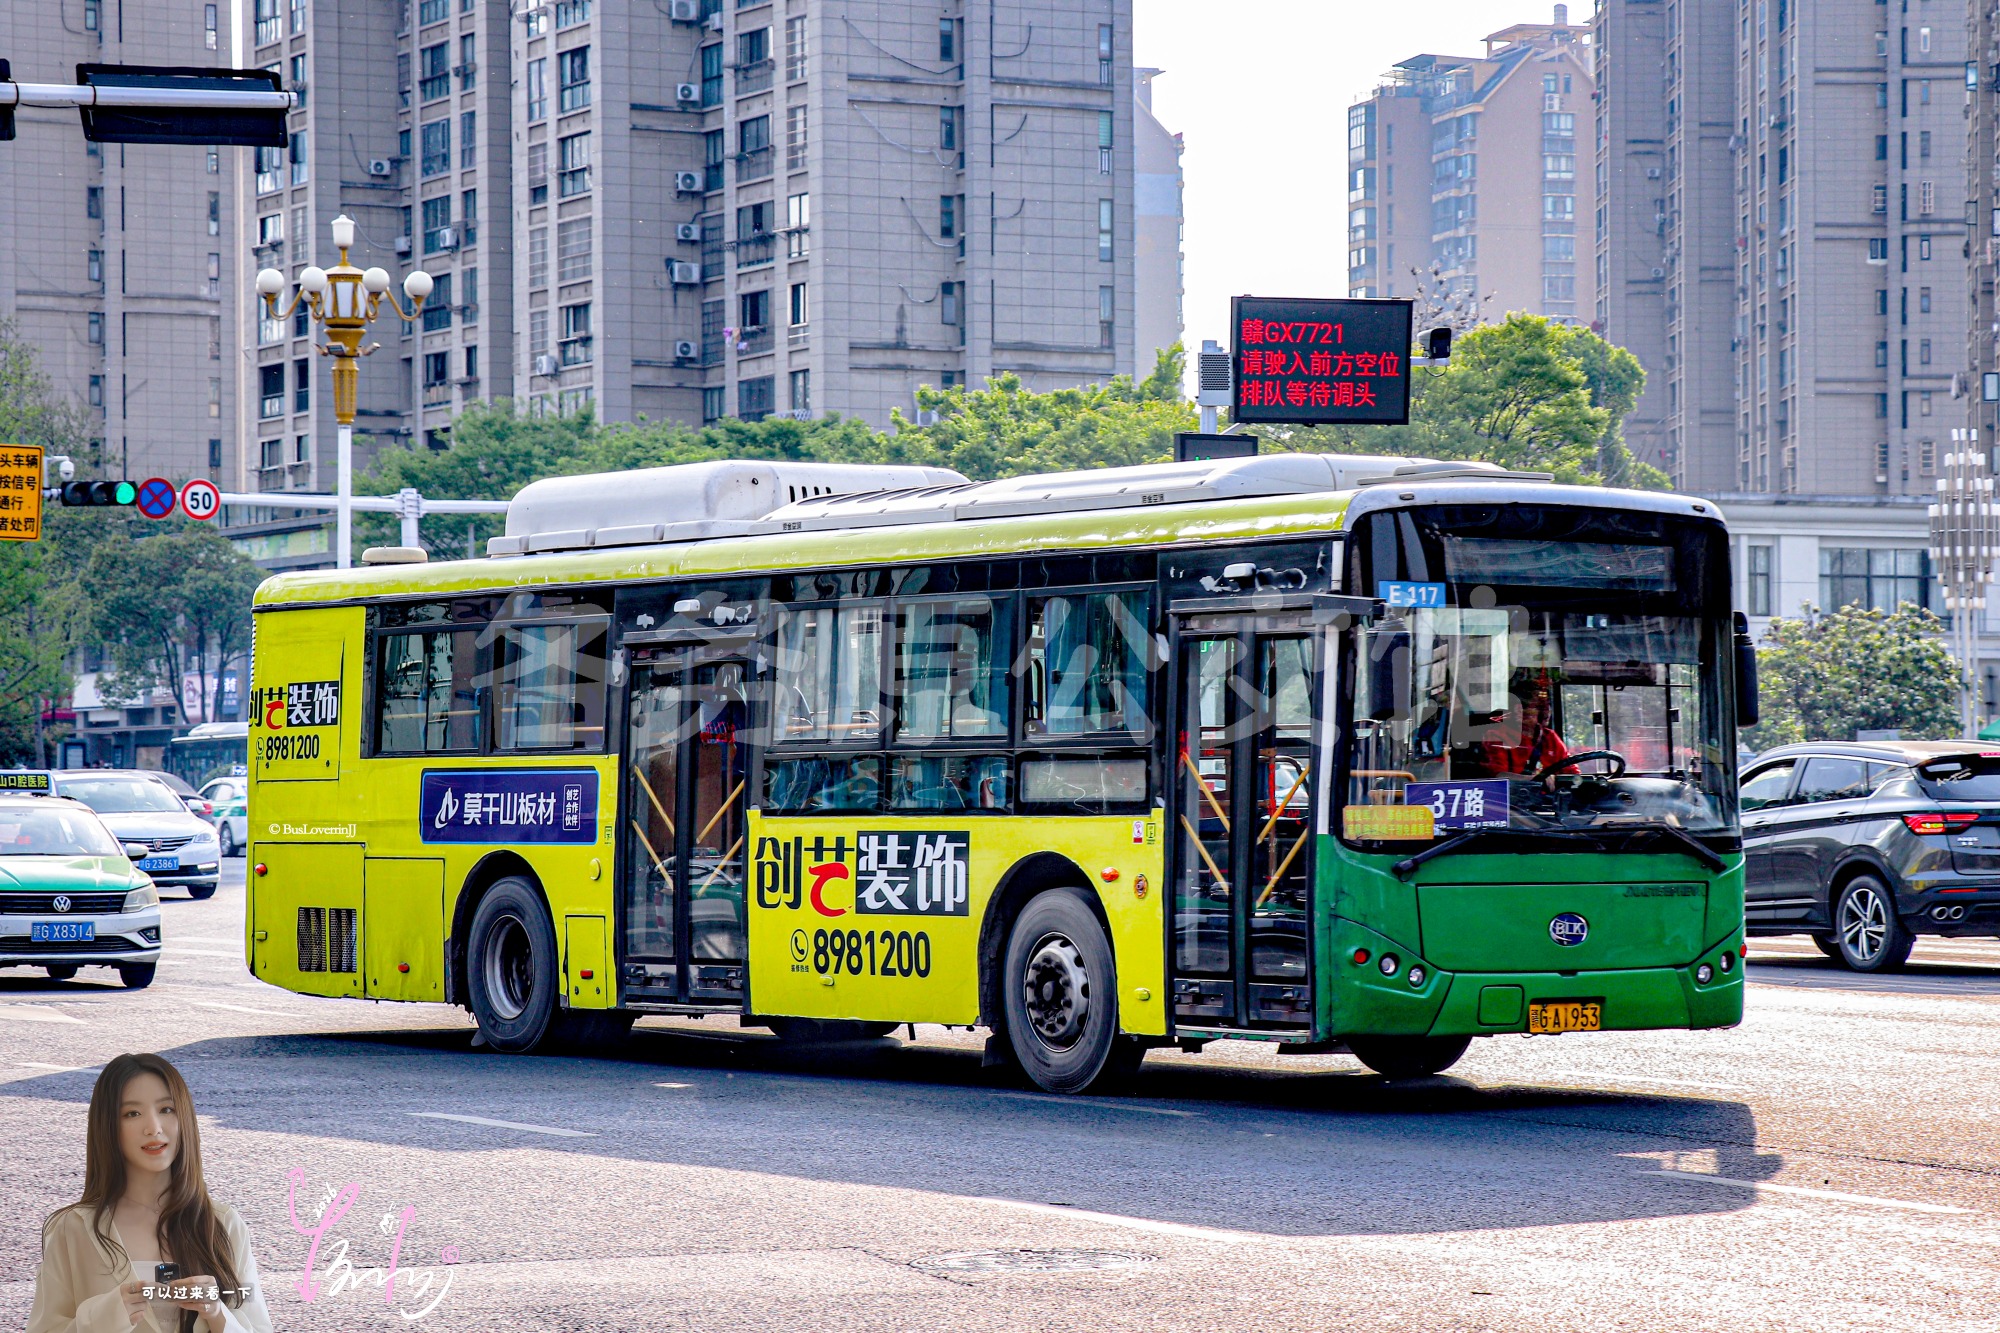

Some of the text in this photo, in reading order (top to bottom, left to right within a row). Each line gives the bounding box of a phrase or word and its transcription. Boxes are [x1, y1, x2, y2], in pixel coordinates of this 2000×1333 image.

[1241, 318, 1343, 345] 赣GX7721
[1241, 350, 1400, 377] 请驶入前方空位
[1240, 381, 1377, 407] 排队等待调头
[0, 453, 38, 468] 头车辆
[190, 492, 212, 510] 50
[0, 516, 35, 532] 者处罚
[1389, 584, 1438, 605] E 117
[266, 734, 320, 761] 8981200
[0, 775, 48, 788] 山口腔医院
[463, 792, 557, 826] 莫干山板材
[565, 801, 579, 814] 合作
[1432, 787, 1484, 819] 37路
[565, 814, 578, 827] 伙伴
[754, 833, 967, 917] 创艺装饰
[1555, 922, 1582, 935] BLK
[813, 928, 931, 978] 8981200
